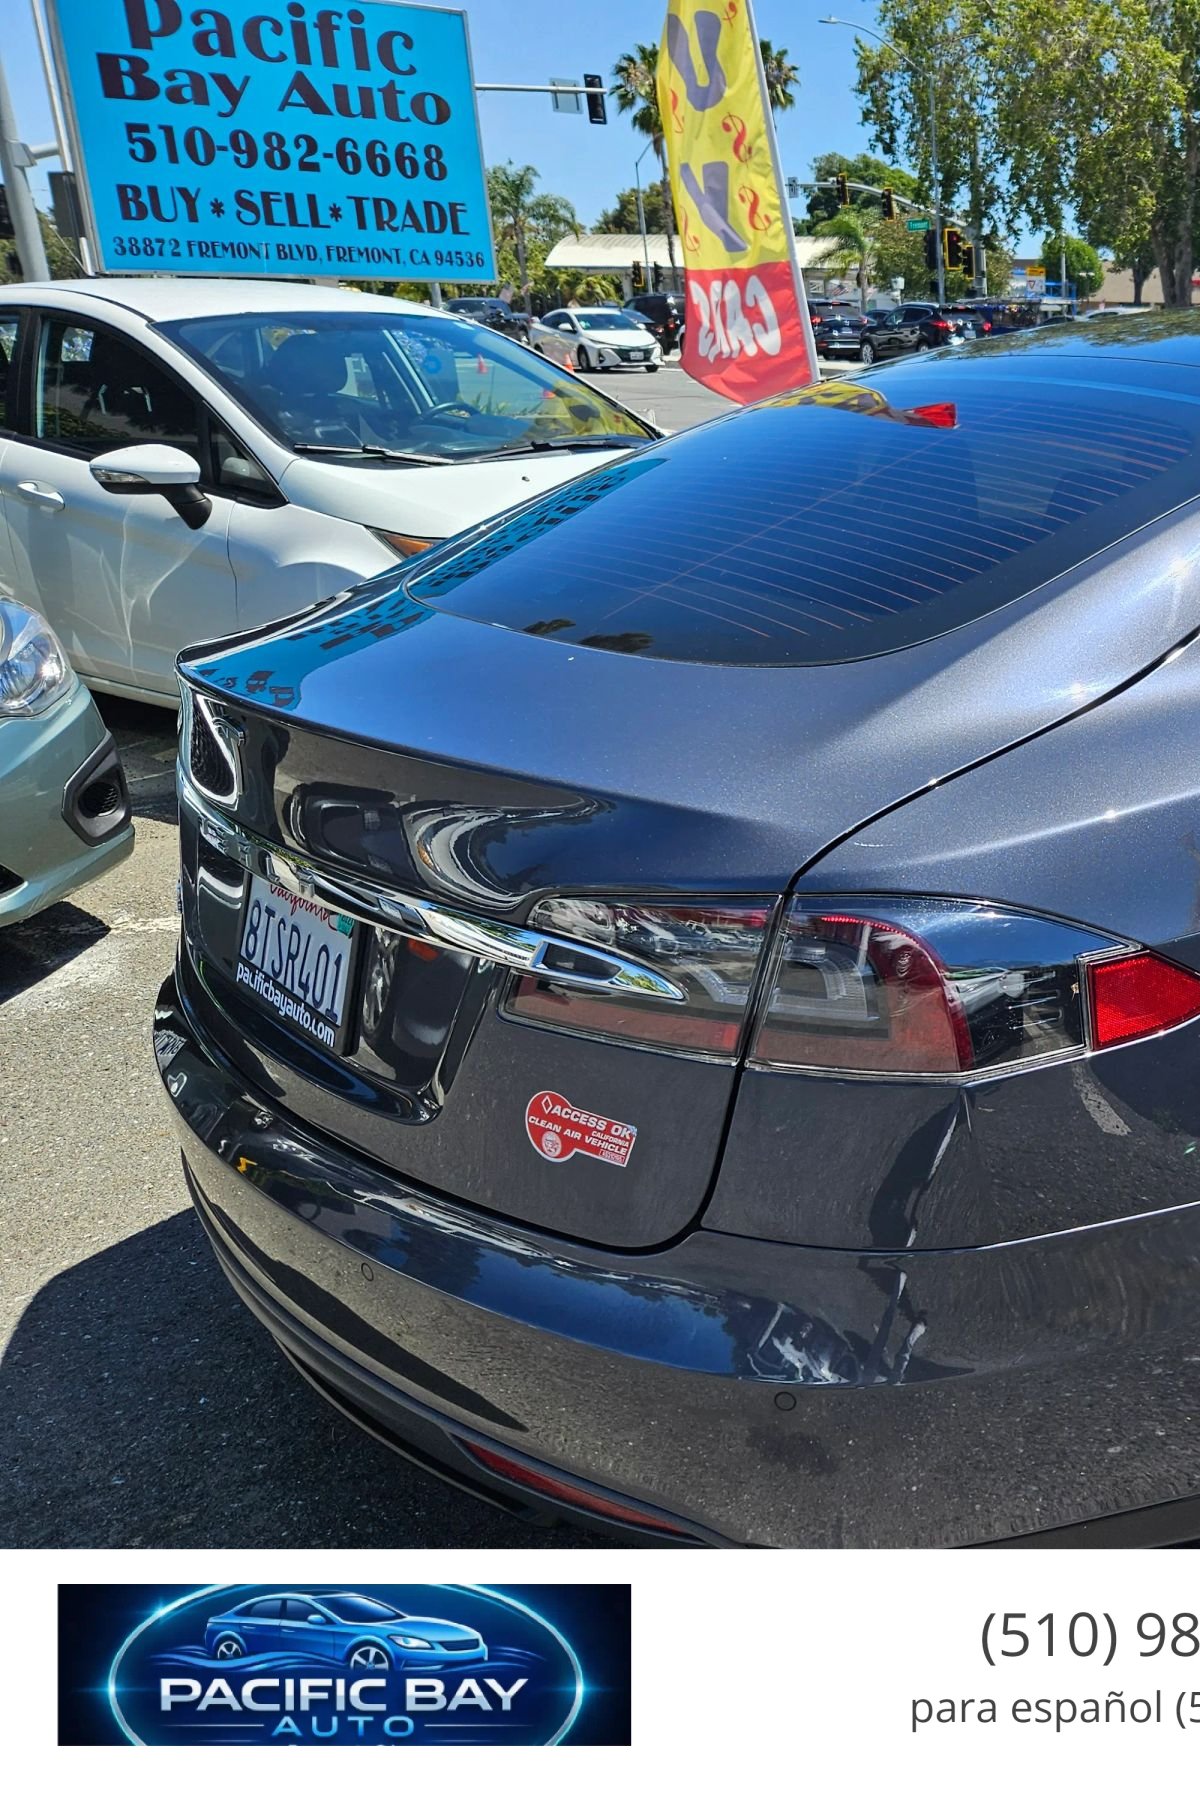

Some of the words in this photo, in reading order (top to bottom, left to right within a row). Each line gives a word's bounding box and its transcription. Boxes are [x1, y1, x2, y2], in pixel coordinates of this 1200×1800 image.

[123, 0, 417, 77] Pacific
[96, 52, 250, 118] Bay
[278, 71, 452, 126] Auto
[125, 122, 448, 181] 510-982-6668
[116, 183, 200, 223] BUY
[235, 189, 330, 229] SELL
[346, 196, 470, 236] TRADE
[113, 237, 182, 257] 38872
[187, 240, 269, 260] FREMONT
[276, 242, 322, 264] BLVD,
[326, 245, 407, 266] FREMONT,
[409, 249, 430, 266] CA
[435, 250, 485, 268] 94536
[244, 899, 344, 1023] 8TSR401
[236, 962, 336, 1048] pacificbayauto.com
[528, 1115, 562, 1133] CLEAN
[563, 1128, 582, 1140] AIR
[584, 1136, 628, 1156] VEHICLE
[551, 1105, 607, 1131] ACCESS
[610, 1125, 631, 1140] OK
